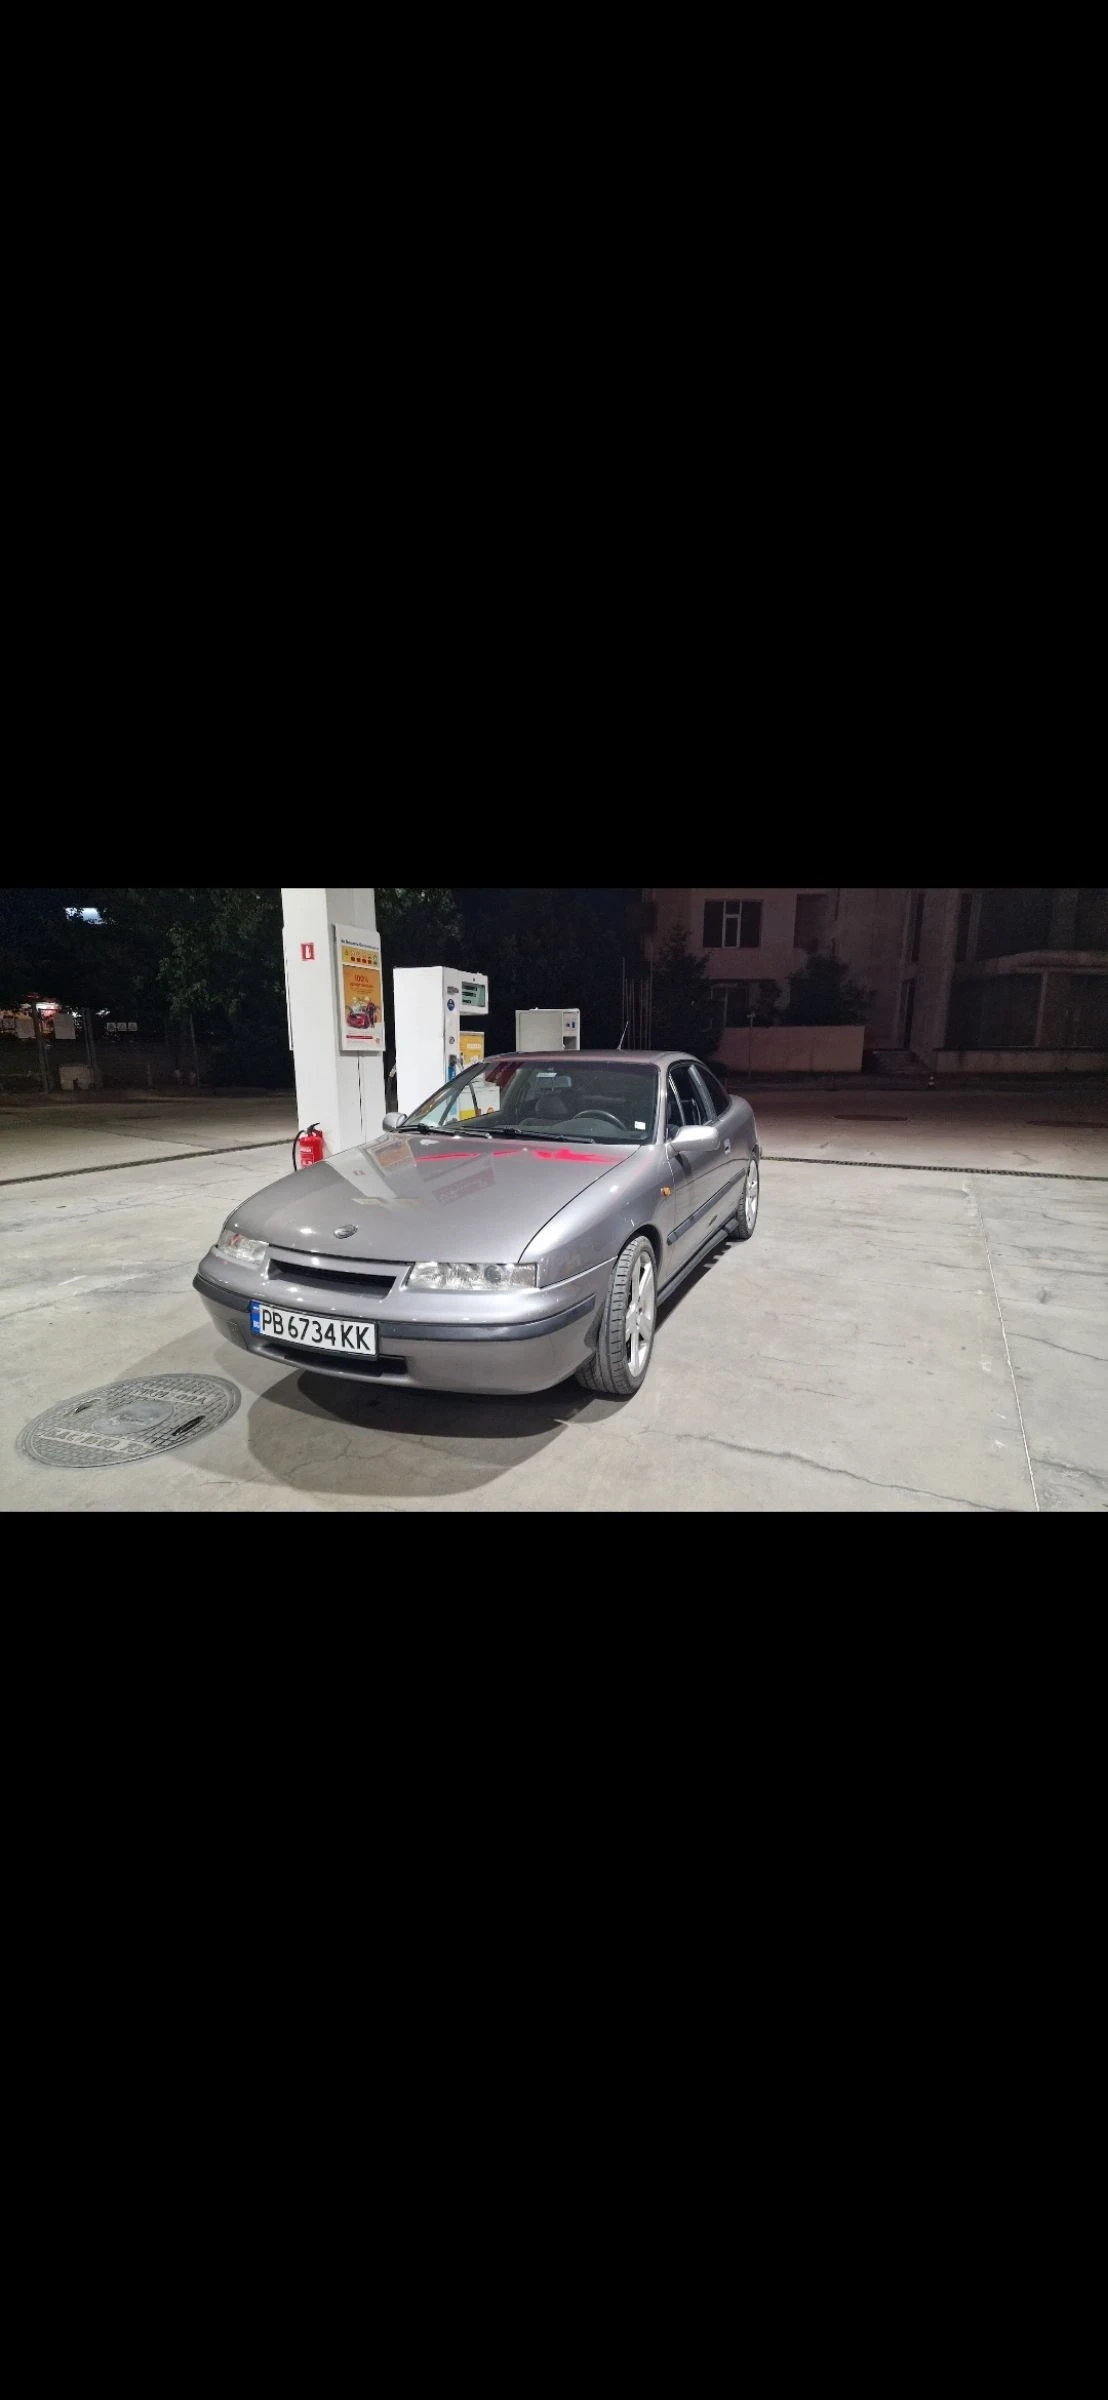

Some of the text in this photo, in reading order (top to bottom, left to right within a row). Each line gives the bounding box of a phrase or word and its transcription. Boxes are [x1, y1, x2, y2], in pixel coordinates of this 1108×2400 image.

[262, 1309, 370, 1351] PB 6734 KK
